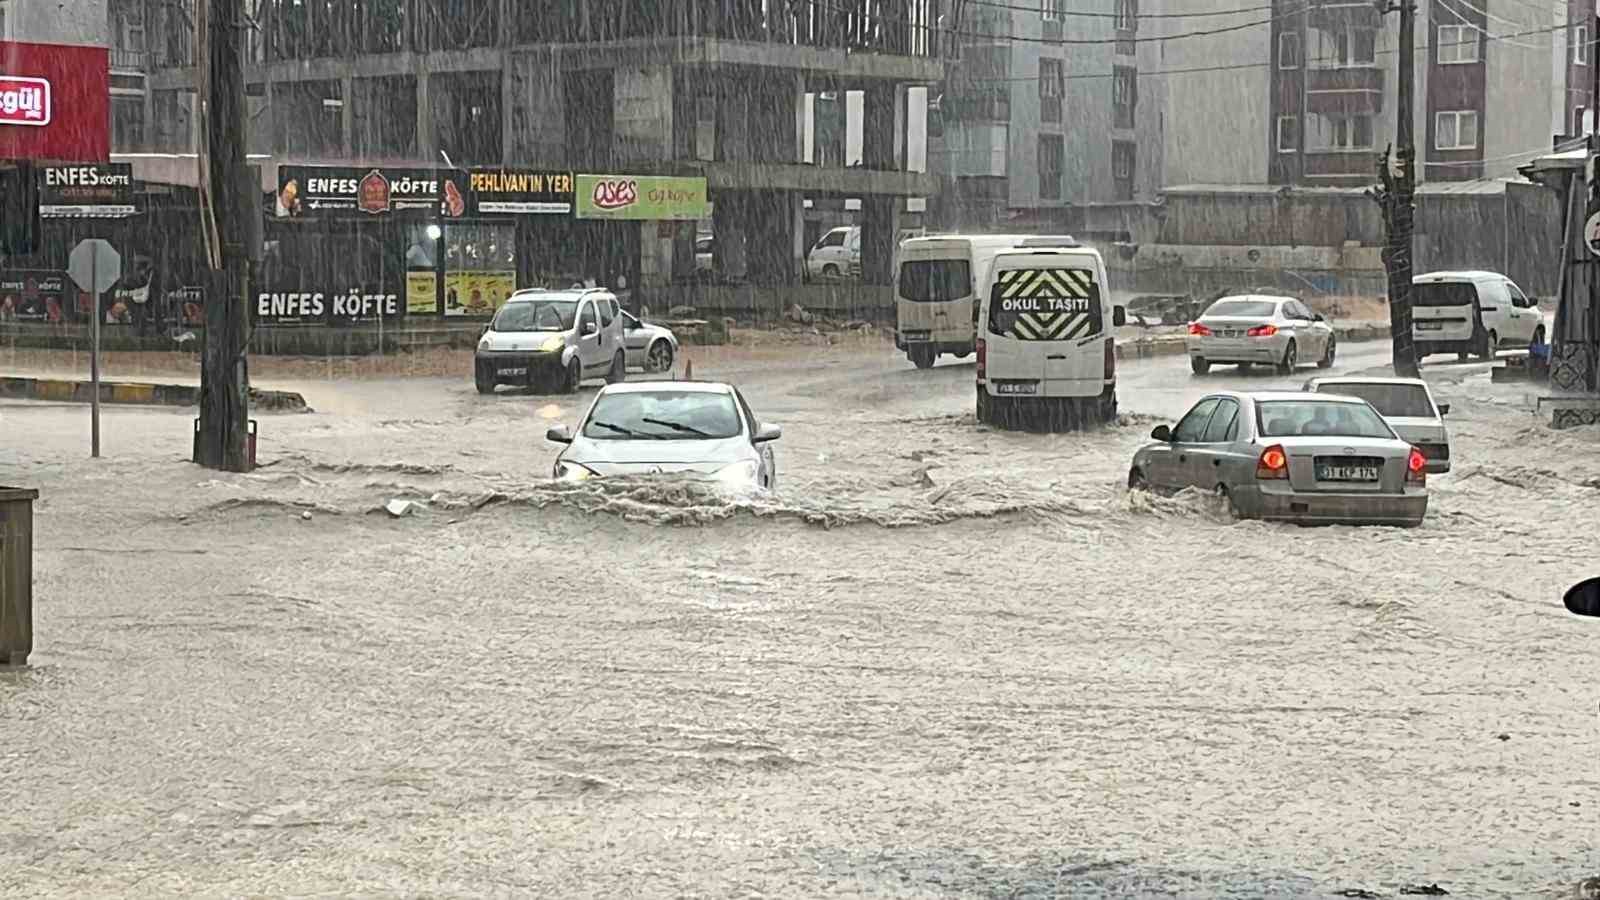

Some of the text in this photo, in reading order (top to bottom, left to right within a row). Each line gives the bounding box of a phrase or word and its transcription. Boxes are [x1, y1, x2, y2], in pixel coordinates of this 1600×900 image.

[46, 167, 99, 185] ENFES
[307, 178, 358, 193] ENFES
[391, 176, 438, 194] KÖFTE
[257, 292, 325, 316] ENFES
[332, 287, 398, 316] KÖFTE
[1002, 298, 1089, 312] OKUL TAŞITI
